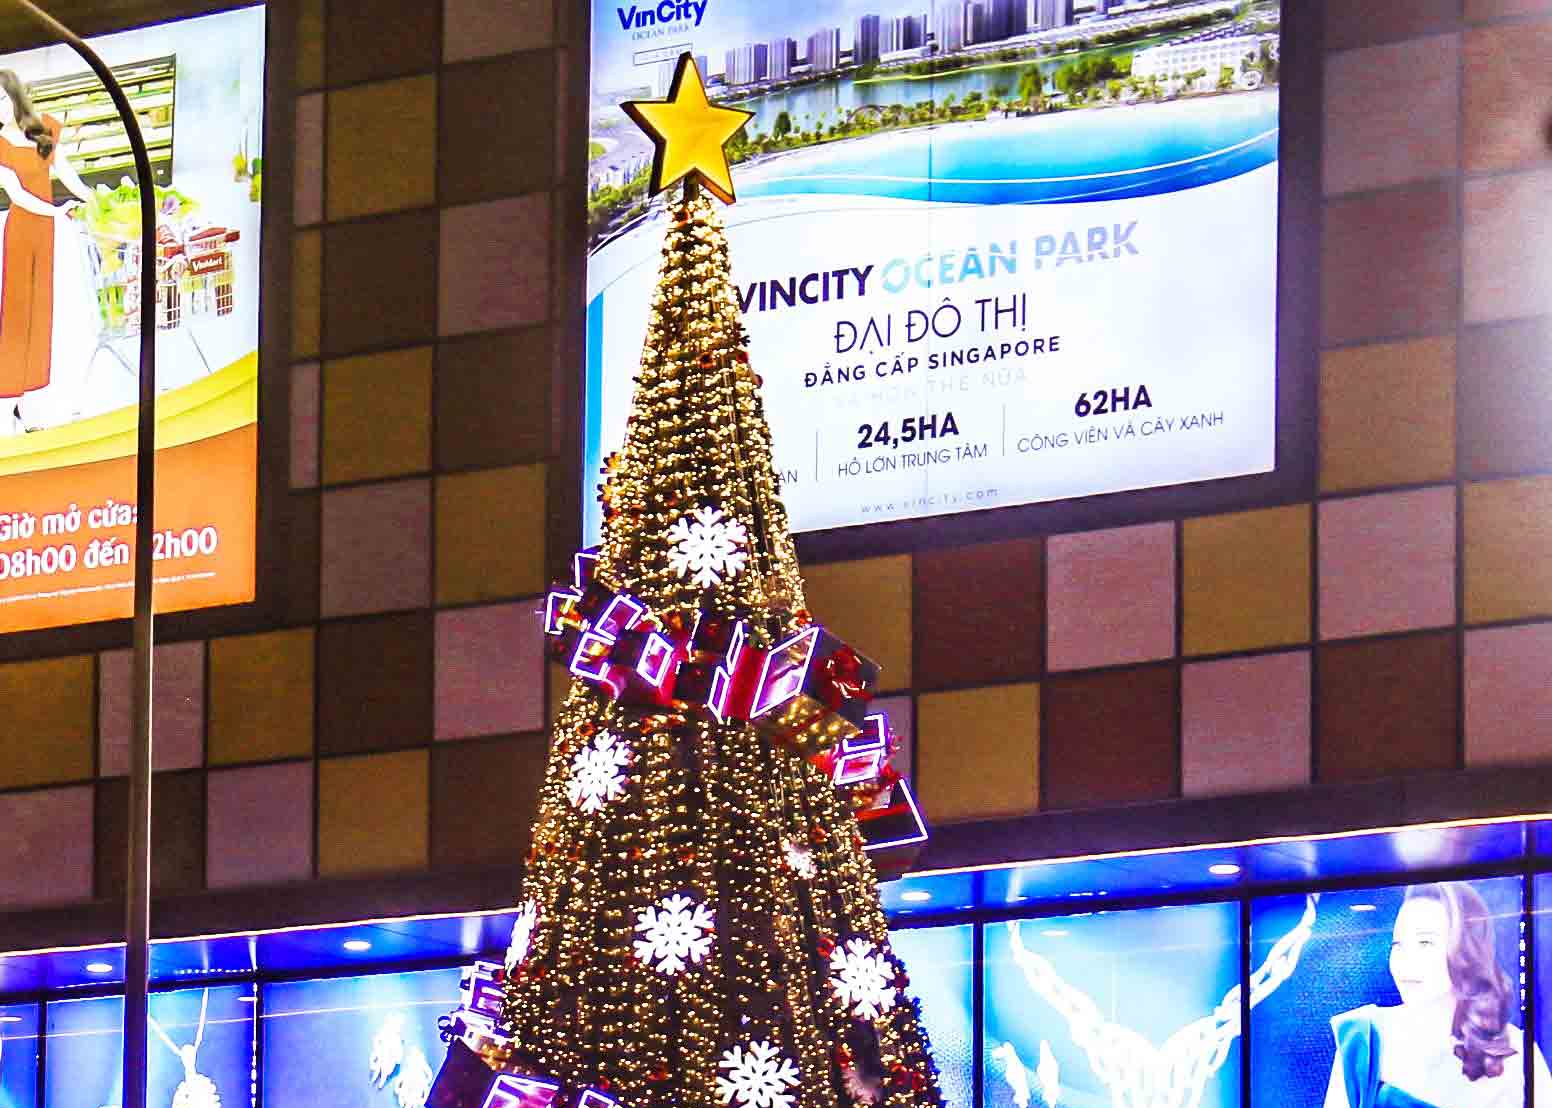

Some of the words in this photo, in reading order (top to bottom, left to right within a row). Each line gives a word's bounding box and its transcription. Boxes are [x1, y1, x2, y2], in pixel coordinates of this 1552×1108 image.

[617, 0, 707, 30] VinCity
[737, 264, 874, 314] VINCITY
[881, 239, 1017, 294] OCEAN
[1035, 220, 1139, 270] PARK
[834, 314, 891, 355] ĐẠI
[905, 297, 962, 343] ĐÔ
[975, 293, 1027, 333] THỊ
[876, 354, 919, 378] CẤP
[928, 336, 1061, 370] SINGAPORE
[1075, 384, 1152, 417] 62HA
[857, 412, 960, 449] 24,5HA
[1017, 432, 1069, 453] CÔNG
[1074, 425, 1108, 445] VIÊN
[1140, 416, 1175, 436] CÂY
[1180, 410, 1224, 431] XANH
[866, 453, 896, 474] LỚN
[901, 449, 951, 470] TRUNG
[957, 442, 988, 462] TÂM
[42, 503, 81, 536] mở
[84, 536, 129, 569] đến
[151, 526, 218, 560] 2h00
